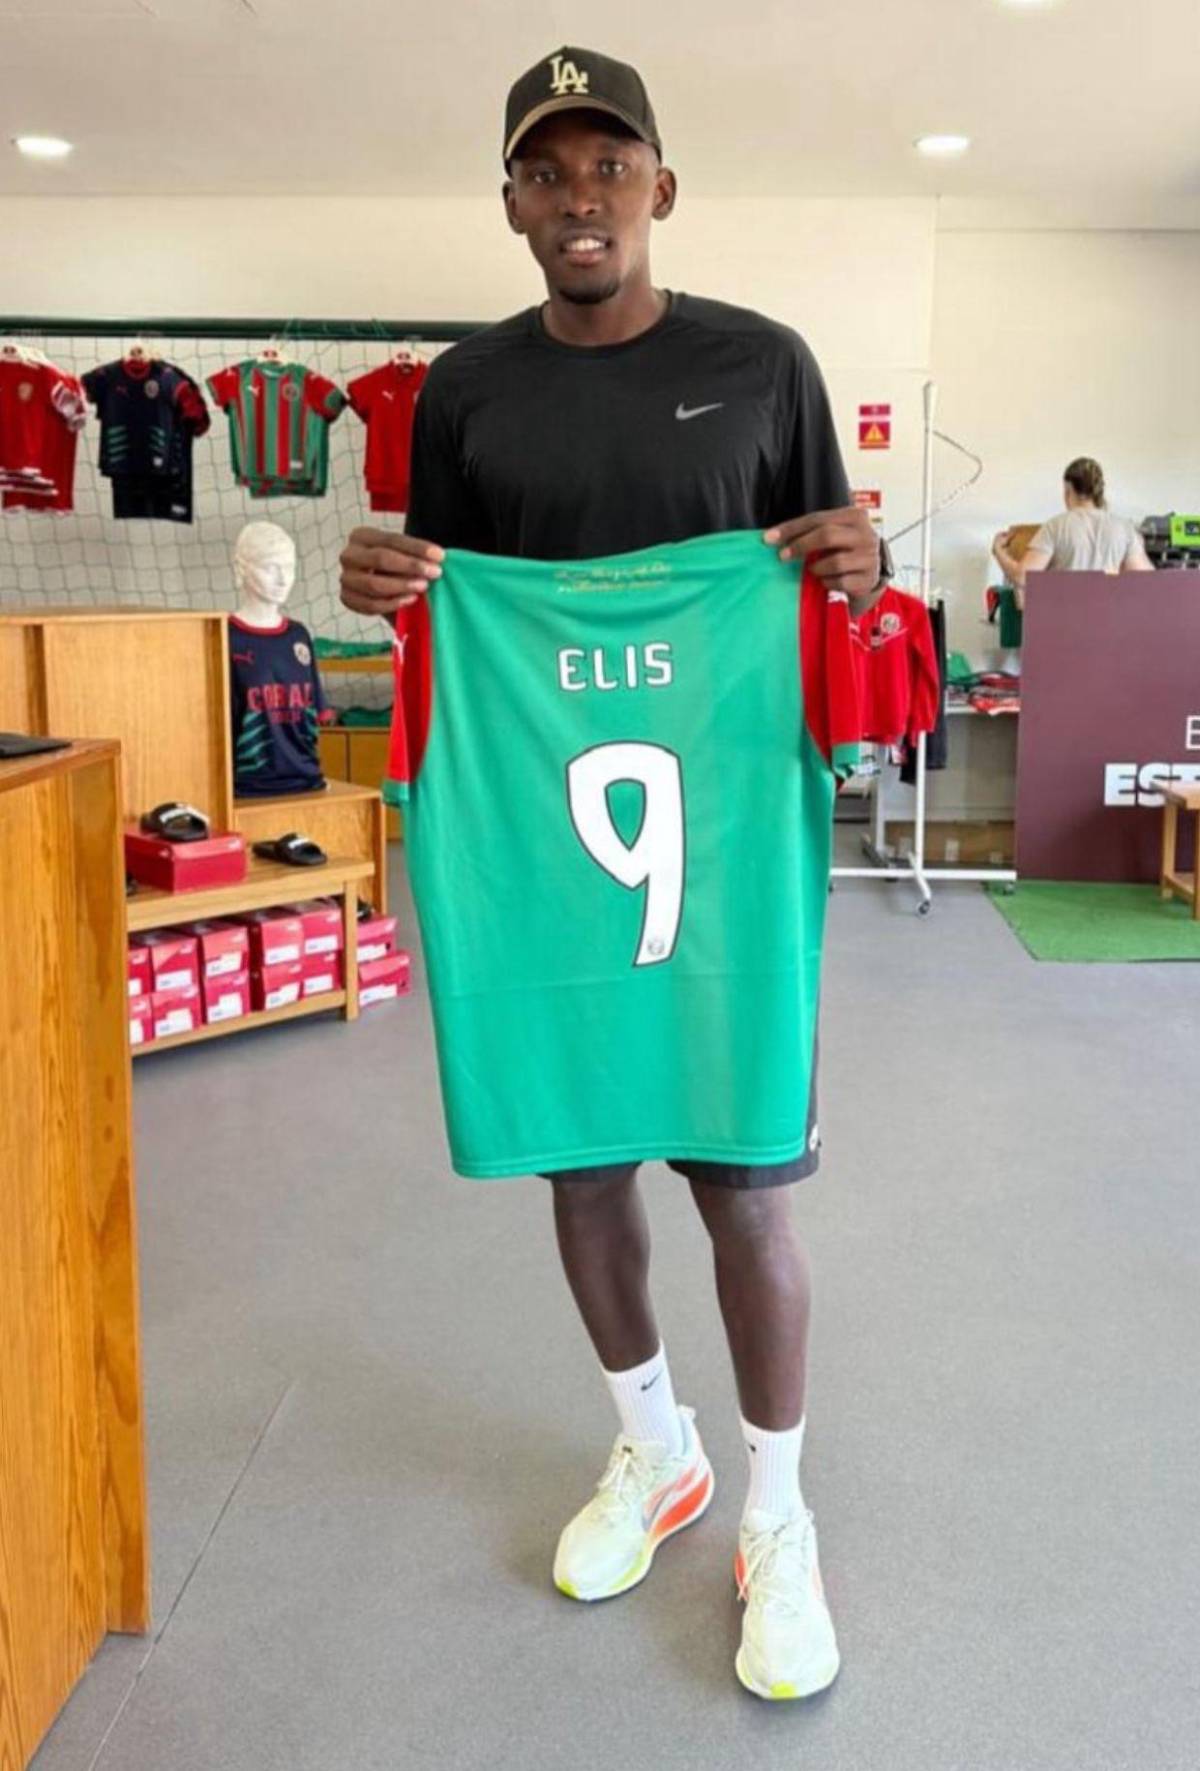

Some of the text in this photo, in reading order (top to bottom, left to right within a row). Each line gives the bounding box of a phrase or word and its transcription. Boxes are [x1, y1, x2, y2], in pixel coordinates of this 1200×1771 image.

[549, 55, 588, 95] LA
[558, 642, 674, 691] ELIS
[565, 740, 686, 966] 9
